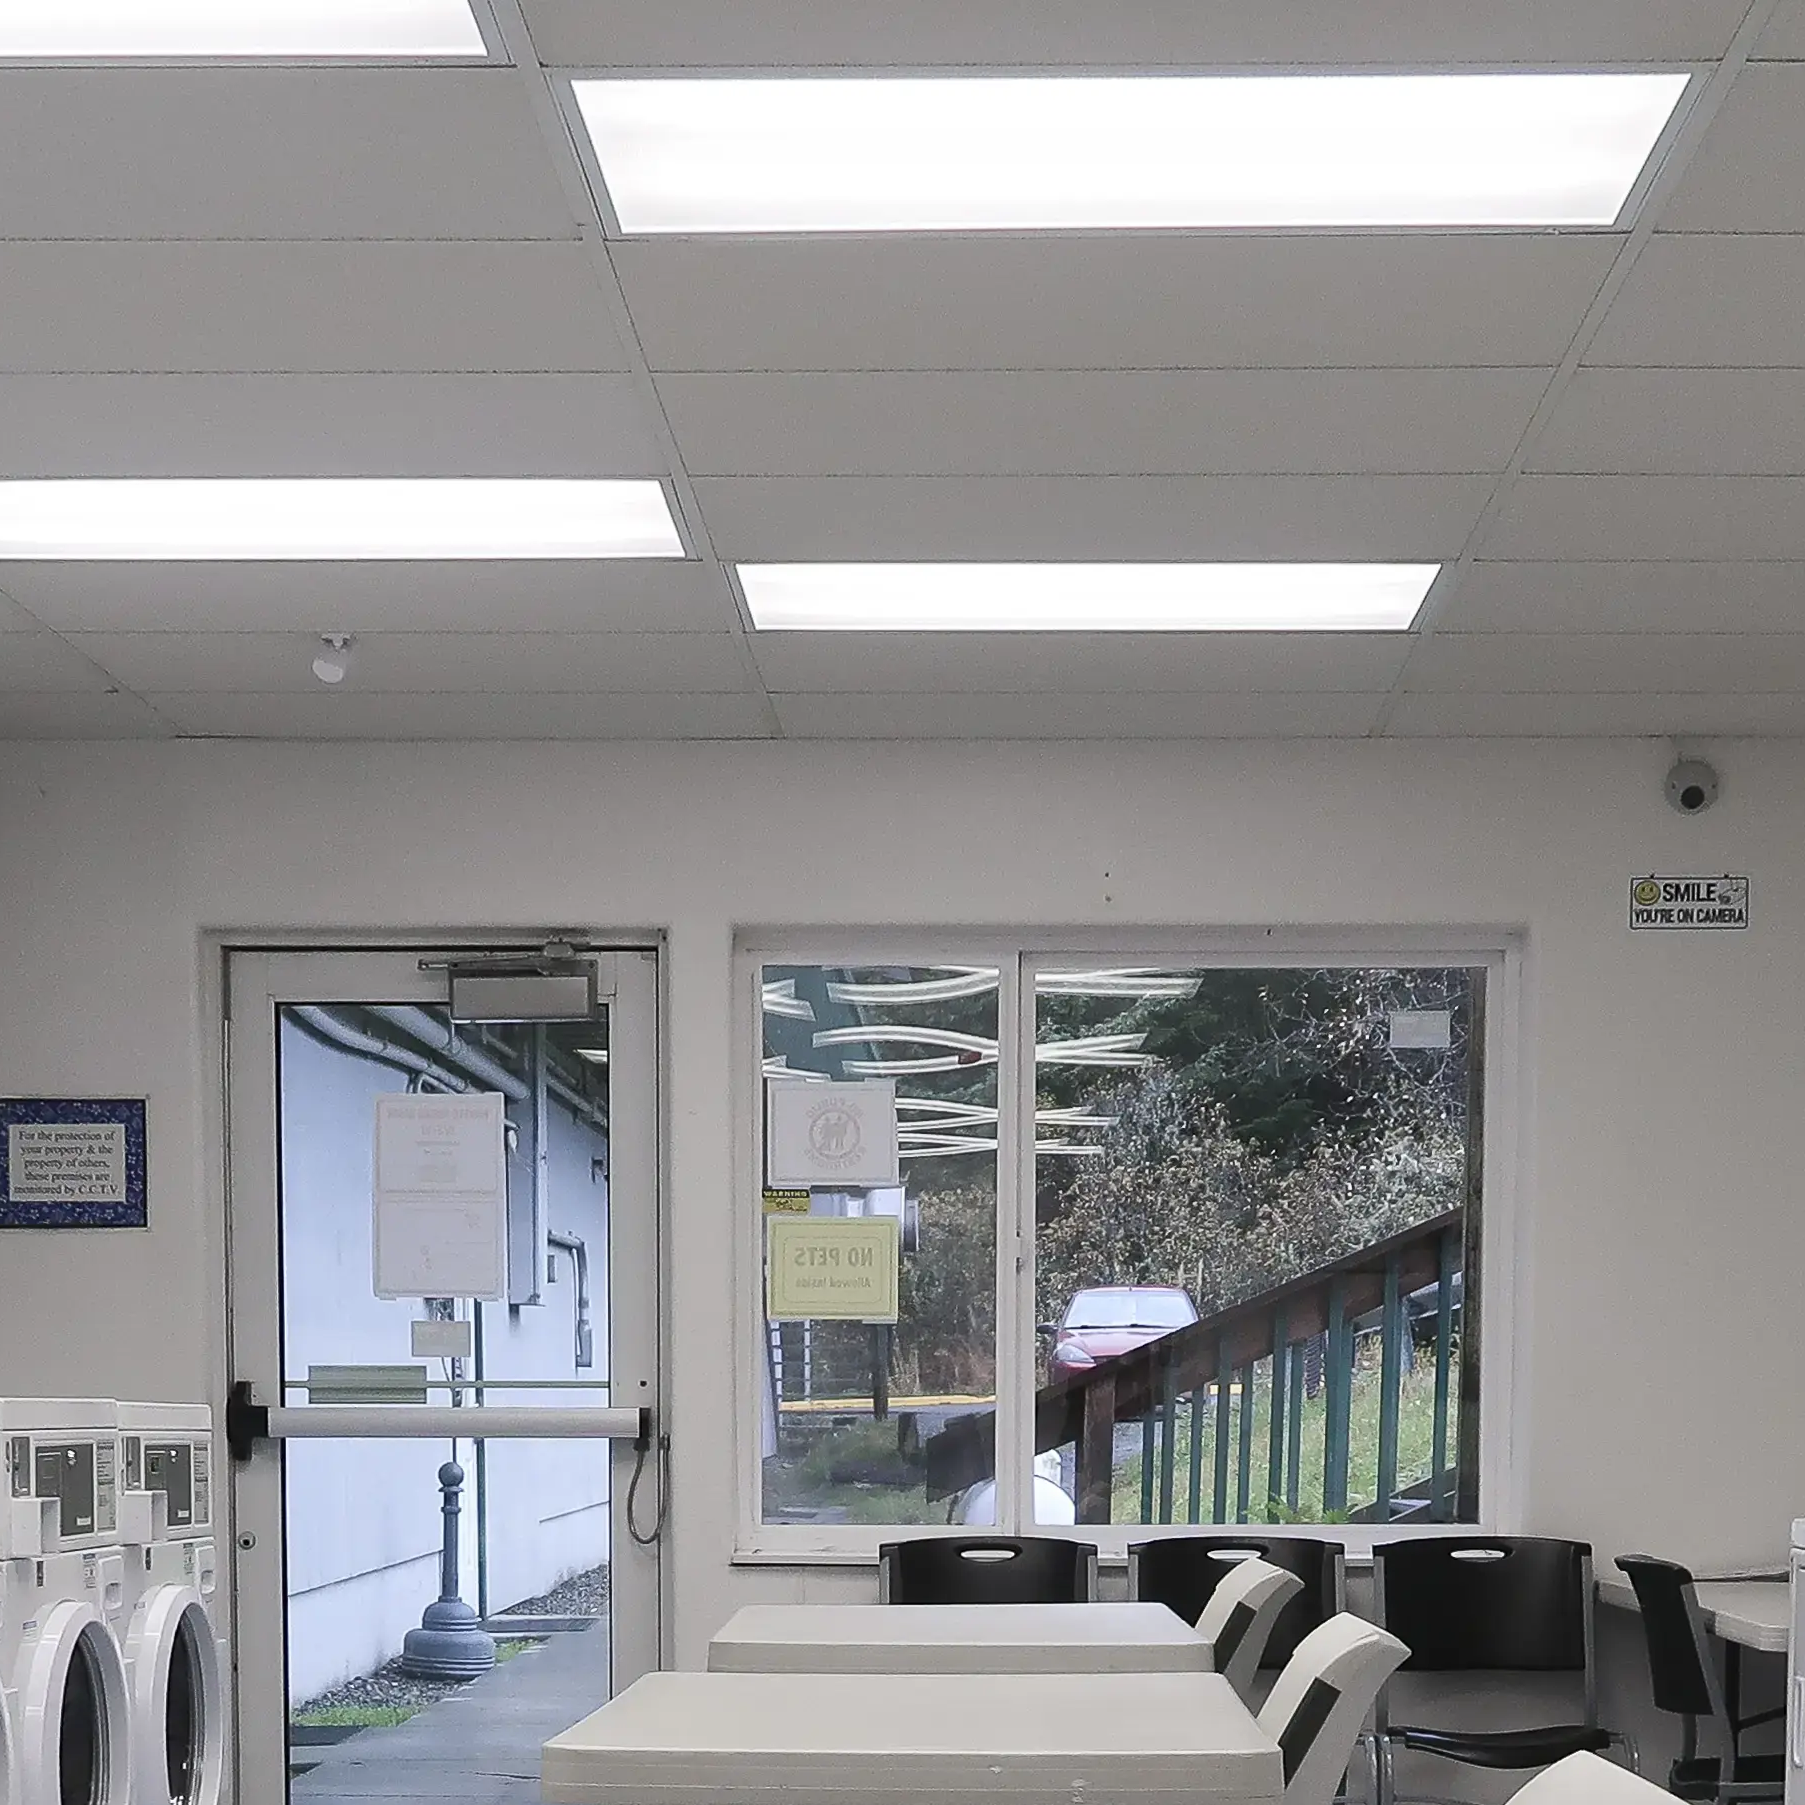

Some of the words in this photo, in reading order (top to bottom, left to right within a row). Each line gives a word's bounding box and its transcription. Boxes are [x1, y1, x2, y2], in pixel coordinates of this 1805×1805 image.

[1663, 882, 1717, 902] SMILE
[1634, 909, 1675, 923] YOU'RE
[1677, 909, 1694, 923] ON
[1697, 909, 1744, 923] CAMERA
[19, 1131, 35, 1140] For
[38, 1130, 53, 1140] the
[54, 1130, 102, 1142] protection
[104, 1131, 116, 1140] of
[20, 1147, 42, 1156] your
[45, 1147, 83, 1156] property
[86, 1145, 95, 1154] &
[98, 1145, 113, 1154] the
[24, 1160, 62, 1169] property
[66, 1159, 76, 1167] of
[25, 1172, 49, 1180] these
[52, 1172, 93, 1182] premises
[14, 1185, 61, 1194] monitored
[64, 1185, 75, 1195] by
